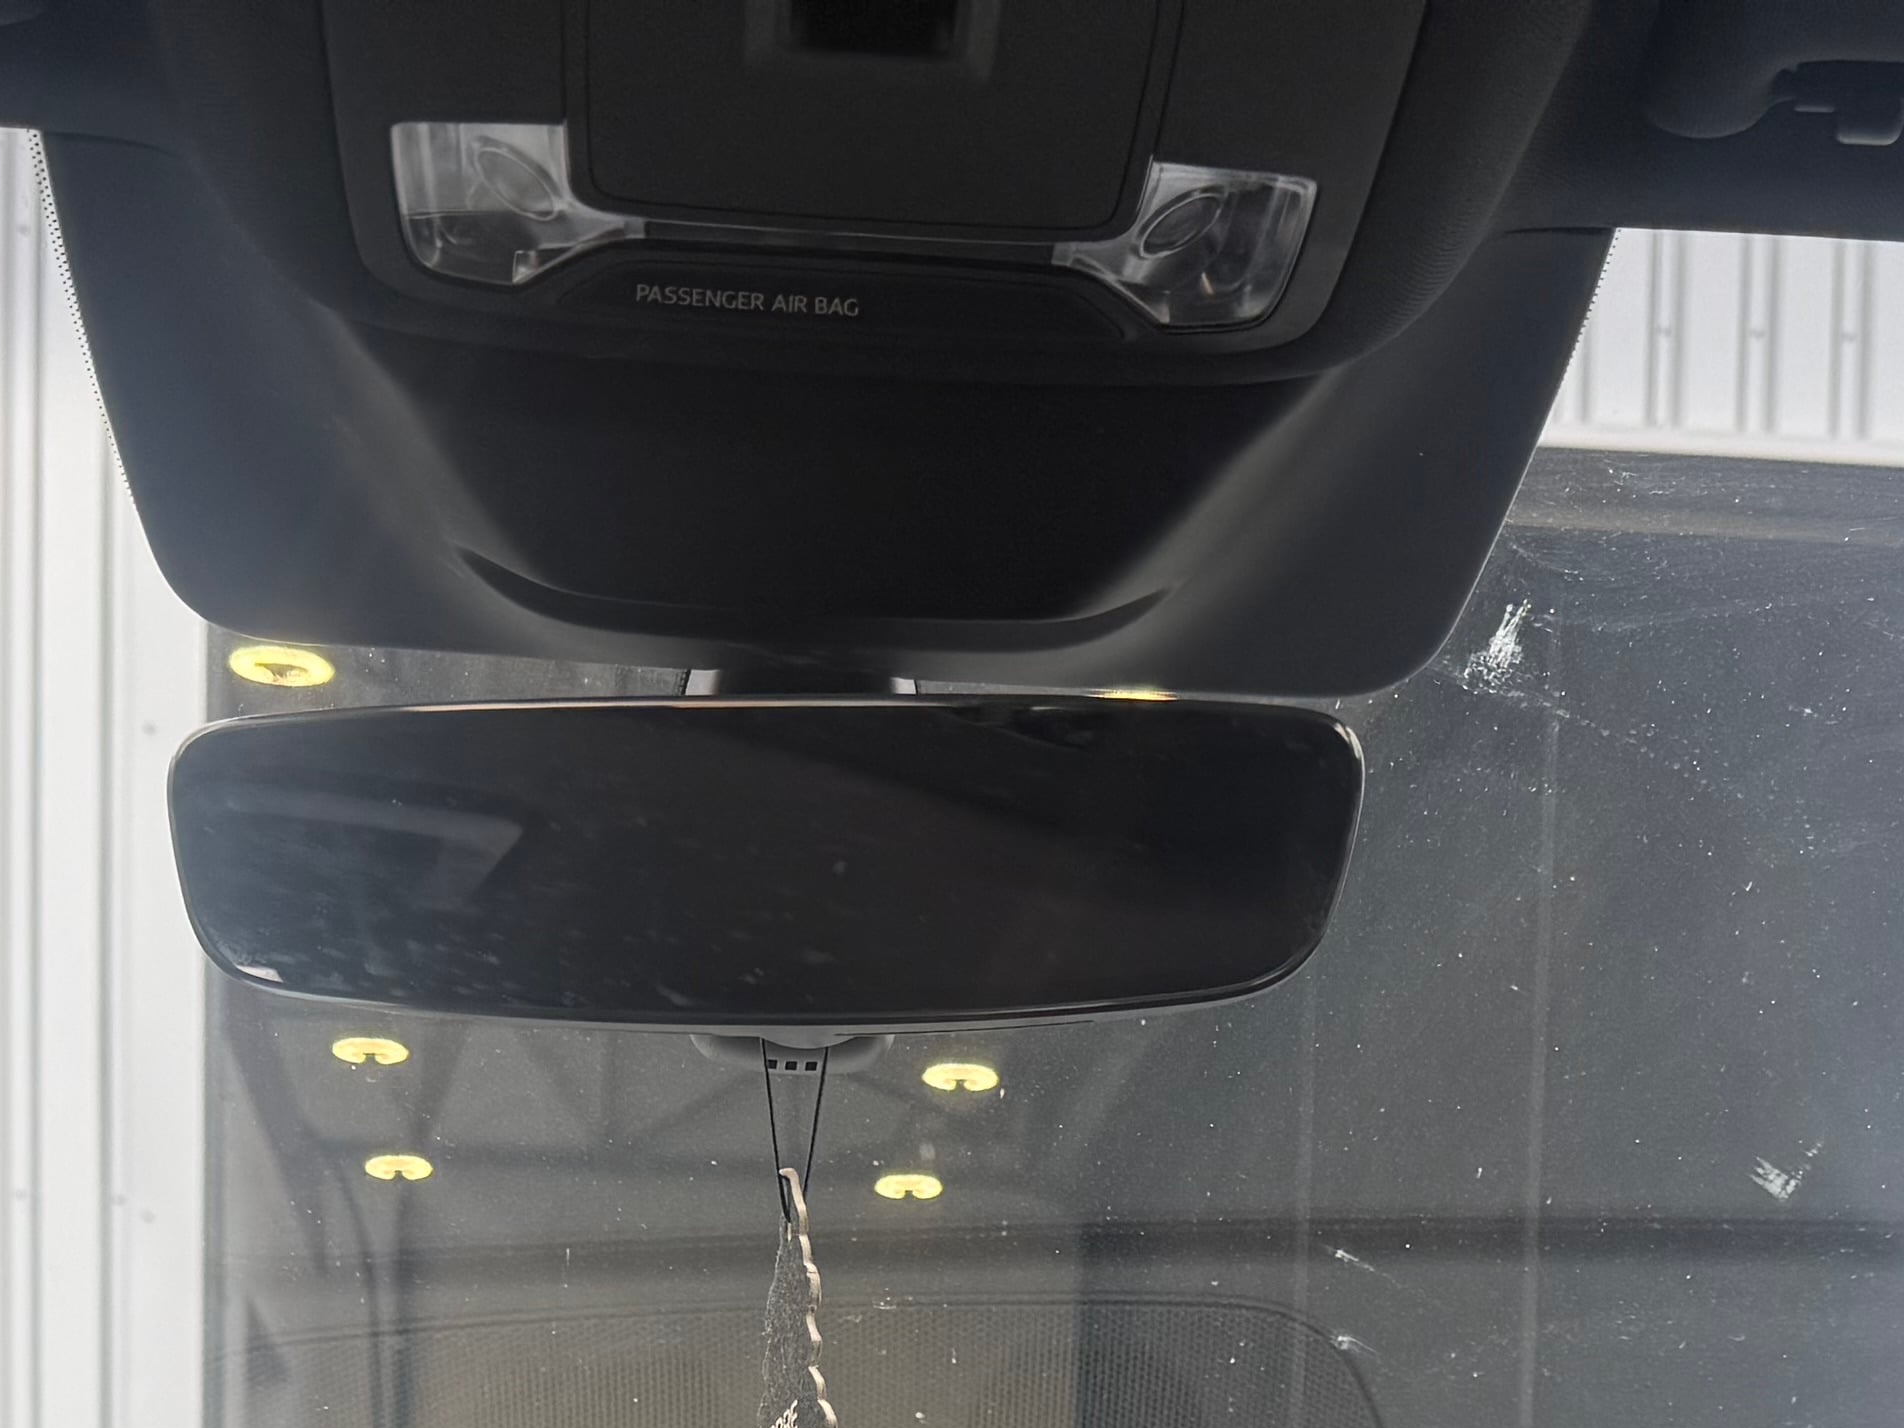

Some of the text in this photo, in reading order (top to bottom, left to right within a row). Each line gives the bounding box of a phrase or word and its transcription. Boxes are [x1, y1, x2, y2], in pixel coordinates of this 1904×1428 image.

[636, 284, 859, 316] PASSENGER AIR BAG
